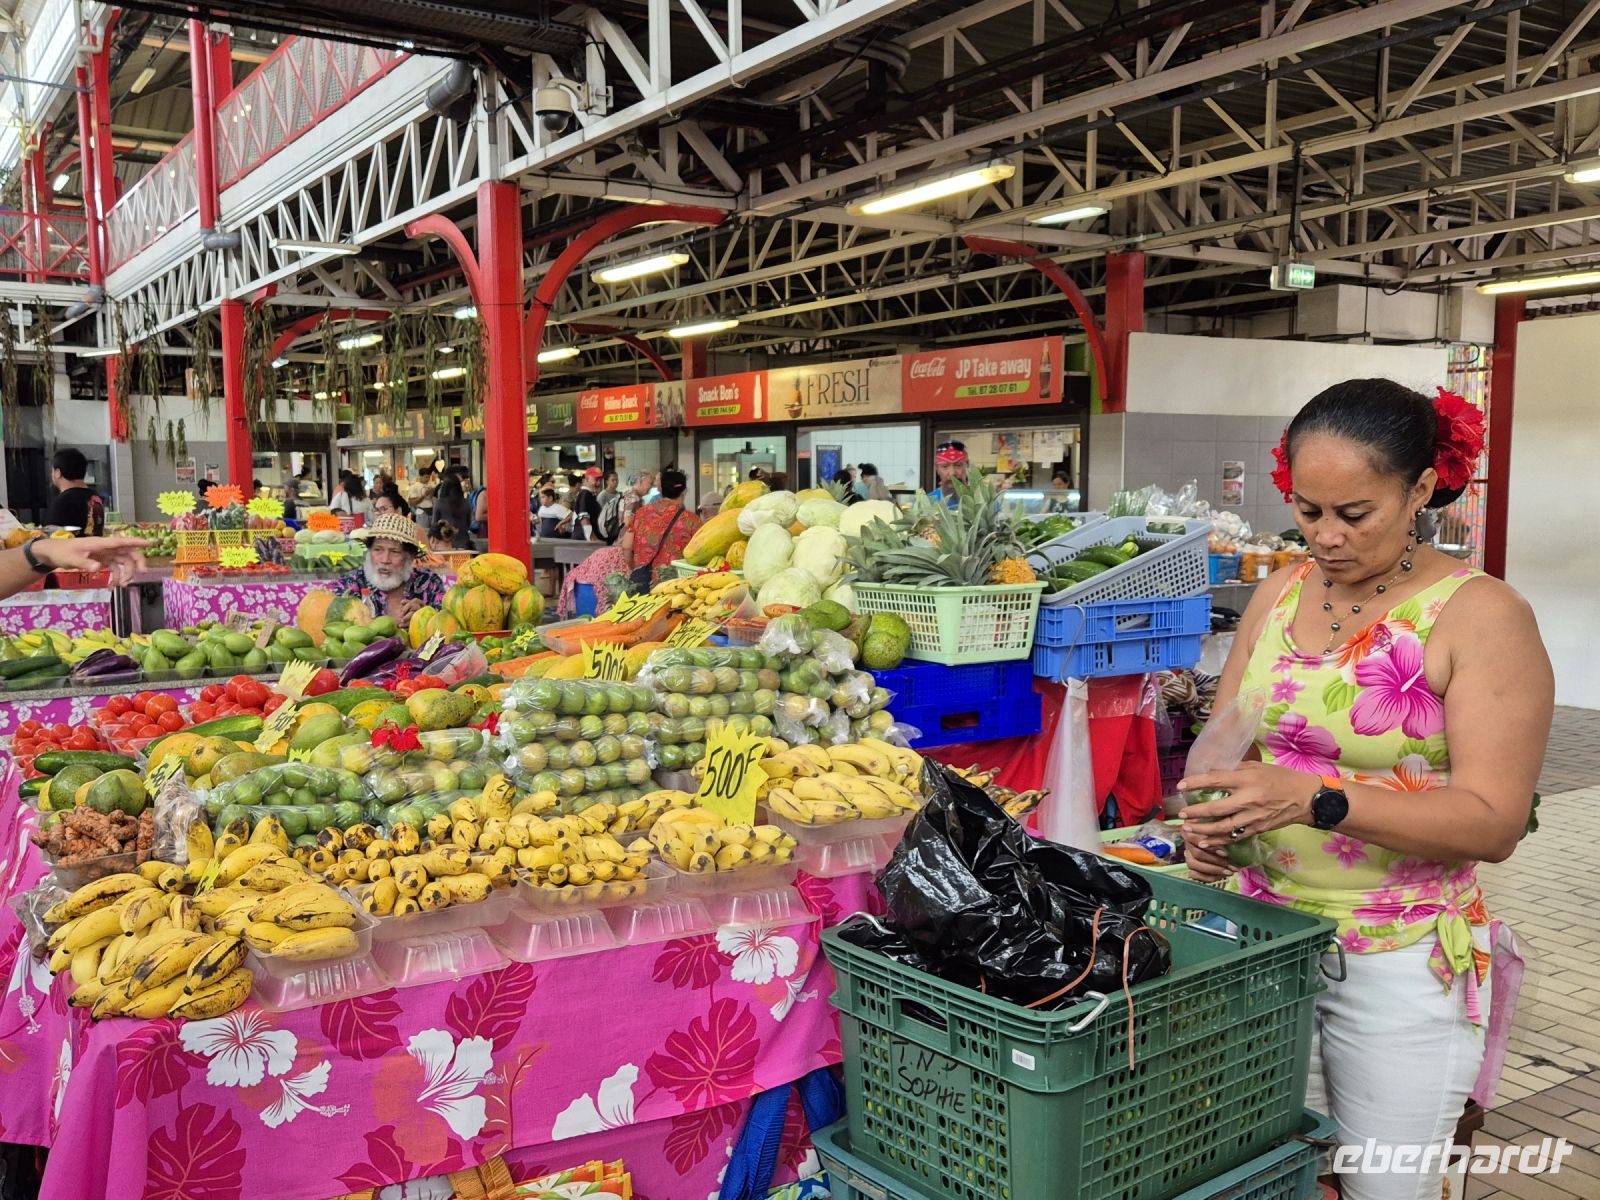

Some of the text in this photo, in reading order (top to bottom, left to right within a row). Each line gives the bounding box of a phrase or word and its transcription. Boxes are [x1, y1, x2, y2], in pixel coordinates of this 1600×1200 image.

[955, 358, 1032, 379] JP Take away
[698, 387, 719, 403] Snack
[806, 368, 870, 406] FRESH
[701, 742, 764, 799] 500F
